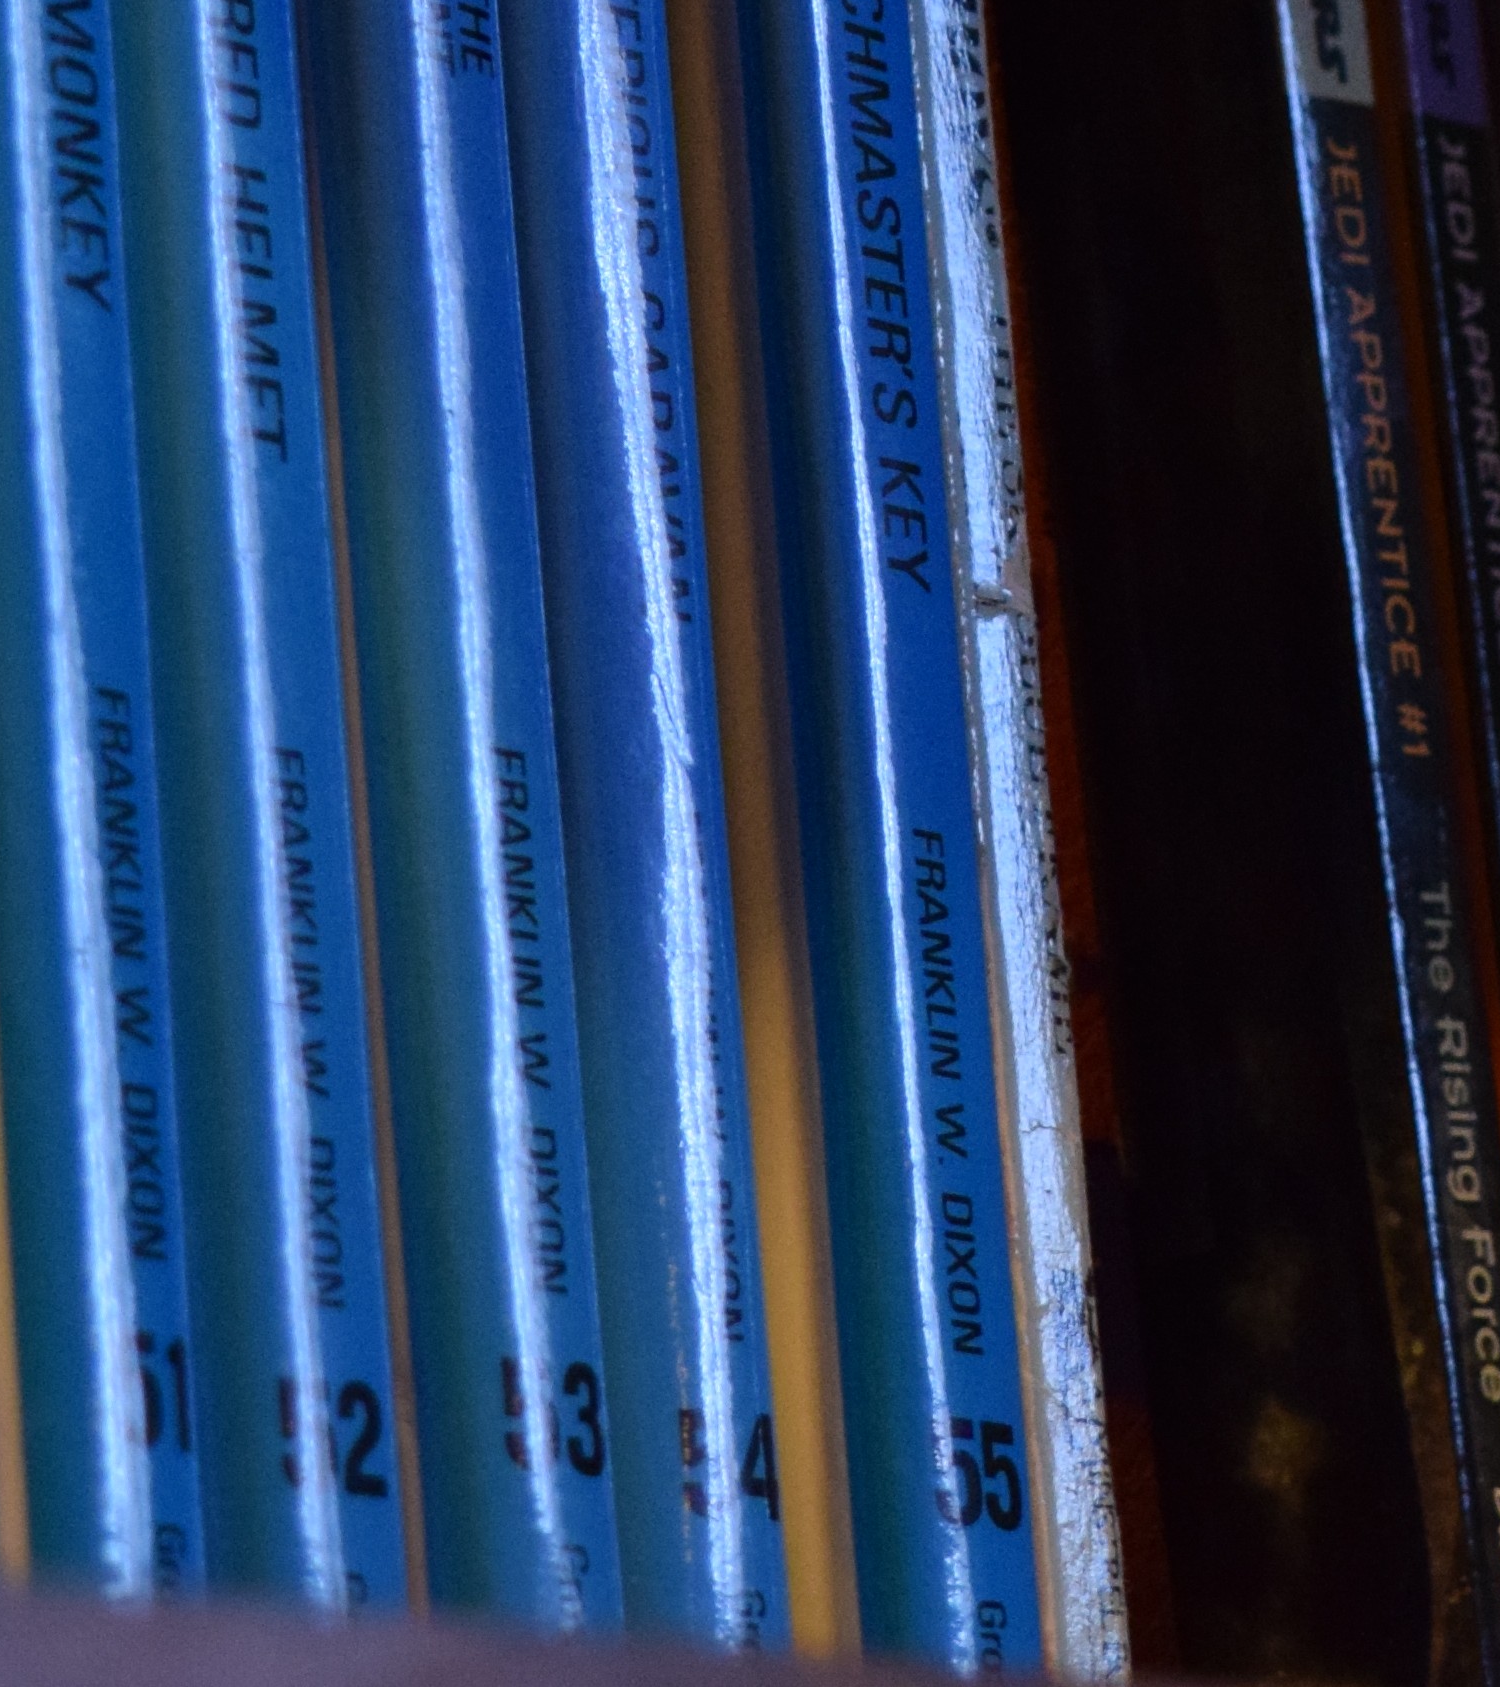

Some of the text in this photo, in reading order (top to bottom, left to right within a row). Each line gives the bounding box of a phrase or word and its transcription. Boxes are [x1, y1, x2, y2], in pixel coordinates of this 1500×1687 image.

[1436, 134, 1480, 263] JEDI
[879, 458, 931, 595] KEY
[1325, 134, 1432, 759] JEDI APPRENTICE #1
[98, 686, 147, 966] FRANKLIN
[274, 745, 323, 1017] FRANKLIN
[307, 1136, 343, 1312] DIXON
[491, 747, 546, 1010] FRANKLIN
[521, 1125, 569, 1298] DIXON
[1416, 882, 1457, 994] The
[121, 1080, 169, 1263] DIXON
[911, 825, 986, 1357] FRANKLIN W. DIXON
[1434, 1014, 1482, 1204] Rising
[500, 1354, 605, 1476] 53
[934, 1416, 1023, 1532] 55
